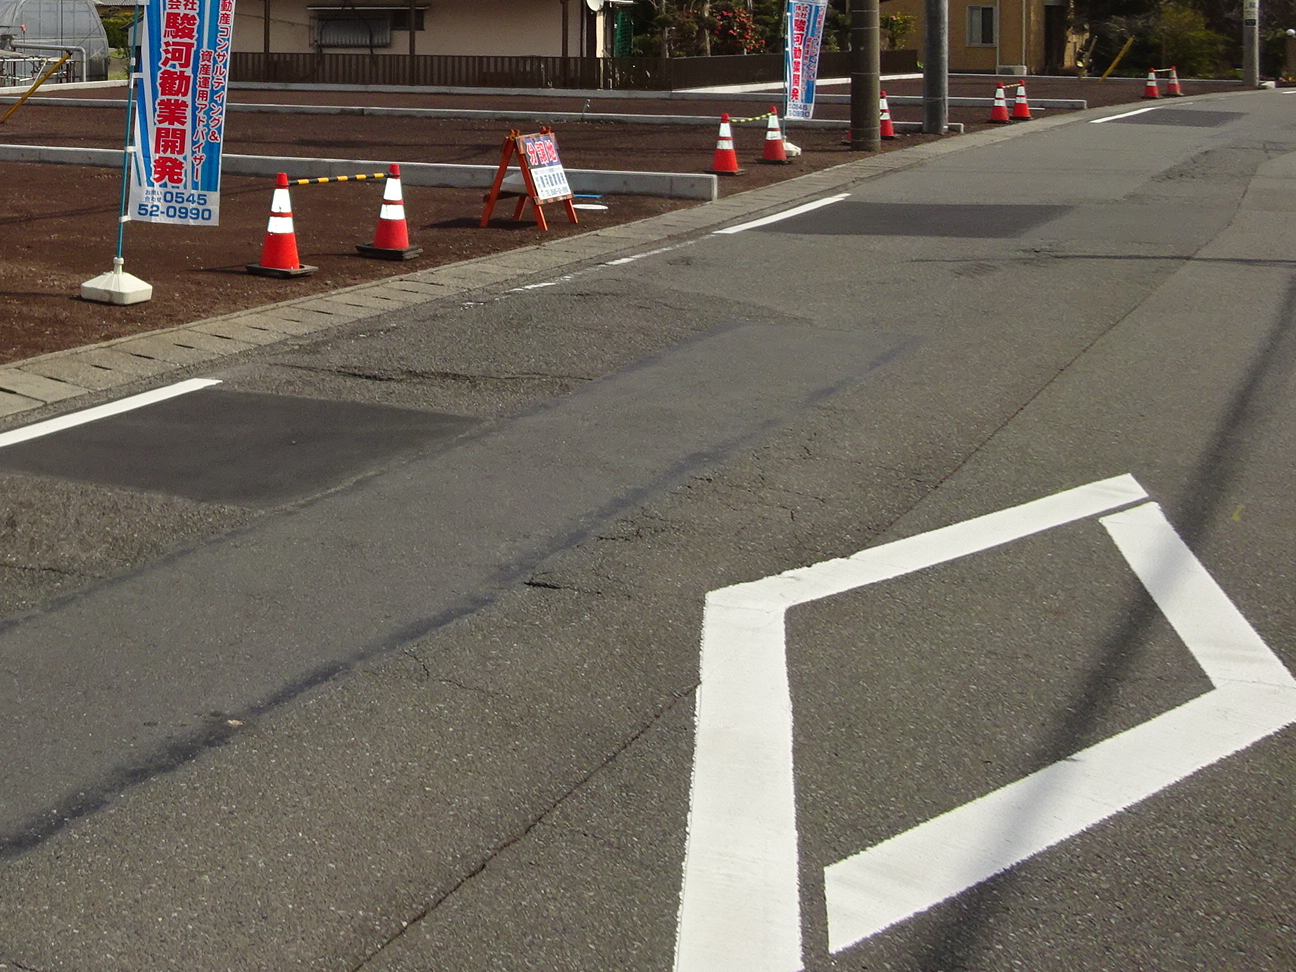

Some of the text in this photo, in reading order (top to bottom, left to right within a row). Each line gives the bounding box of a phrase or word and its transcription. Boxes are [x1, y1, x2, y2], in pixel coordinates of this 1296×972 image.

[152, 12, 198, 185] 駿河勧業開発
[192, 50, 213, 181] 資産運用アドバイザー
[137, 203, 212, 221] 52-0990
[163, 191, 208, 206] 0545
